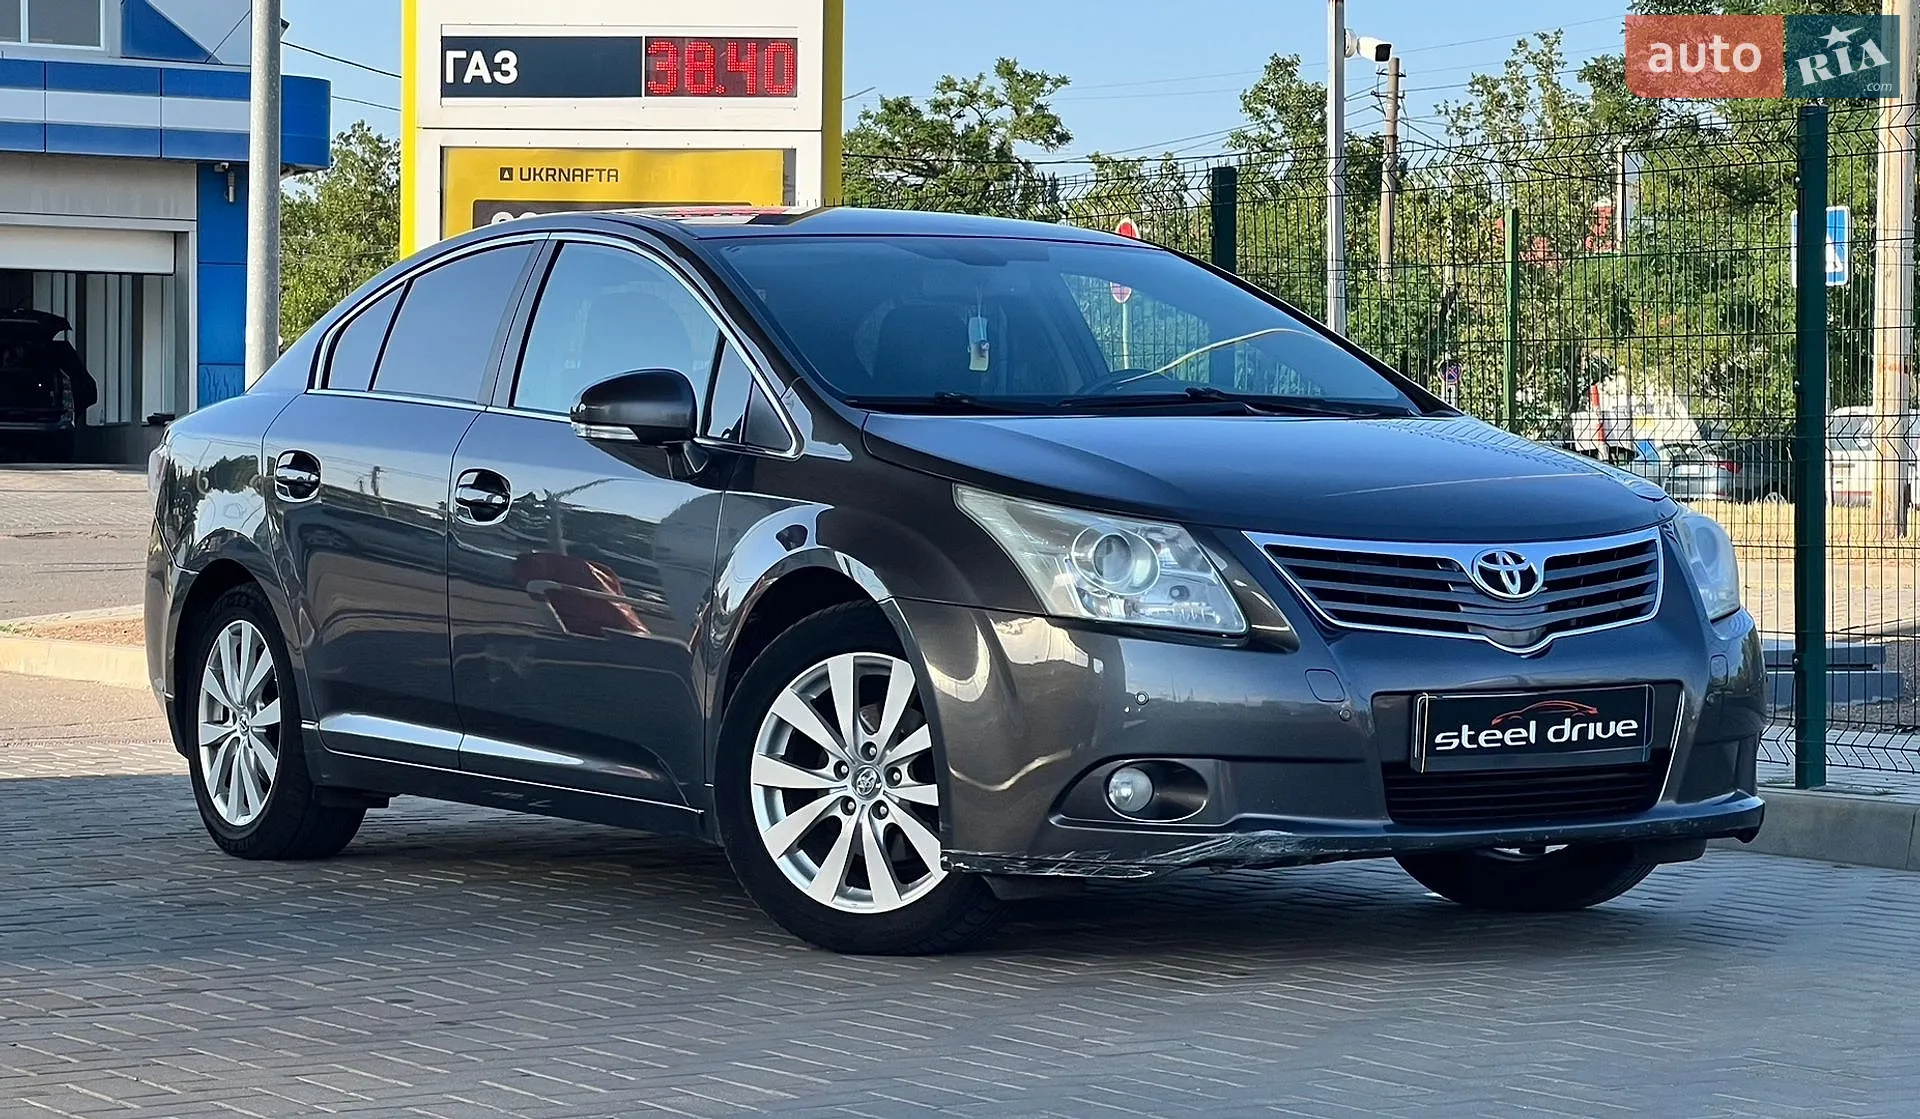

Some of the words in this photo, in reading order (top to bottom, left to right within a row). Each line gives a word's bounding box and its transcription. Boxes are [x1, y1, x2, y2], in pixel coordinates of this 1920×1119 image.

[445, 49, 519, 84] ГАЗ
[647, 41, 794, 95] 38.40
[519, 166, 619, 183] UKRNAFTA
[1434, 720, 1537, 751] steel
[1546, 717, 1639, 744] drive
